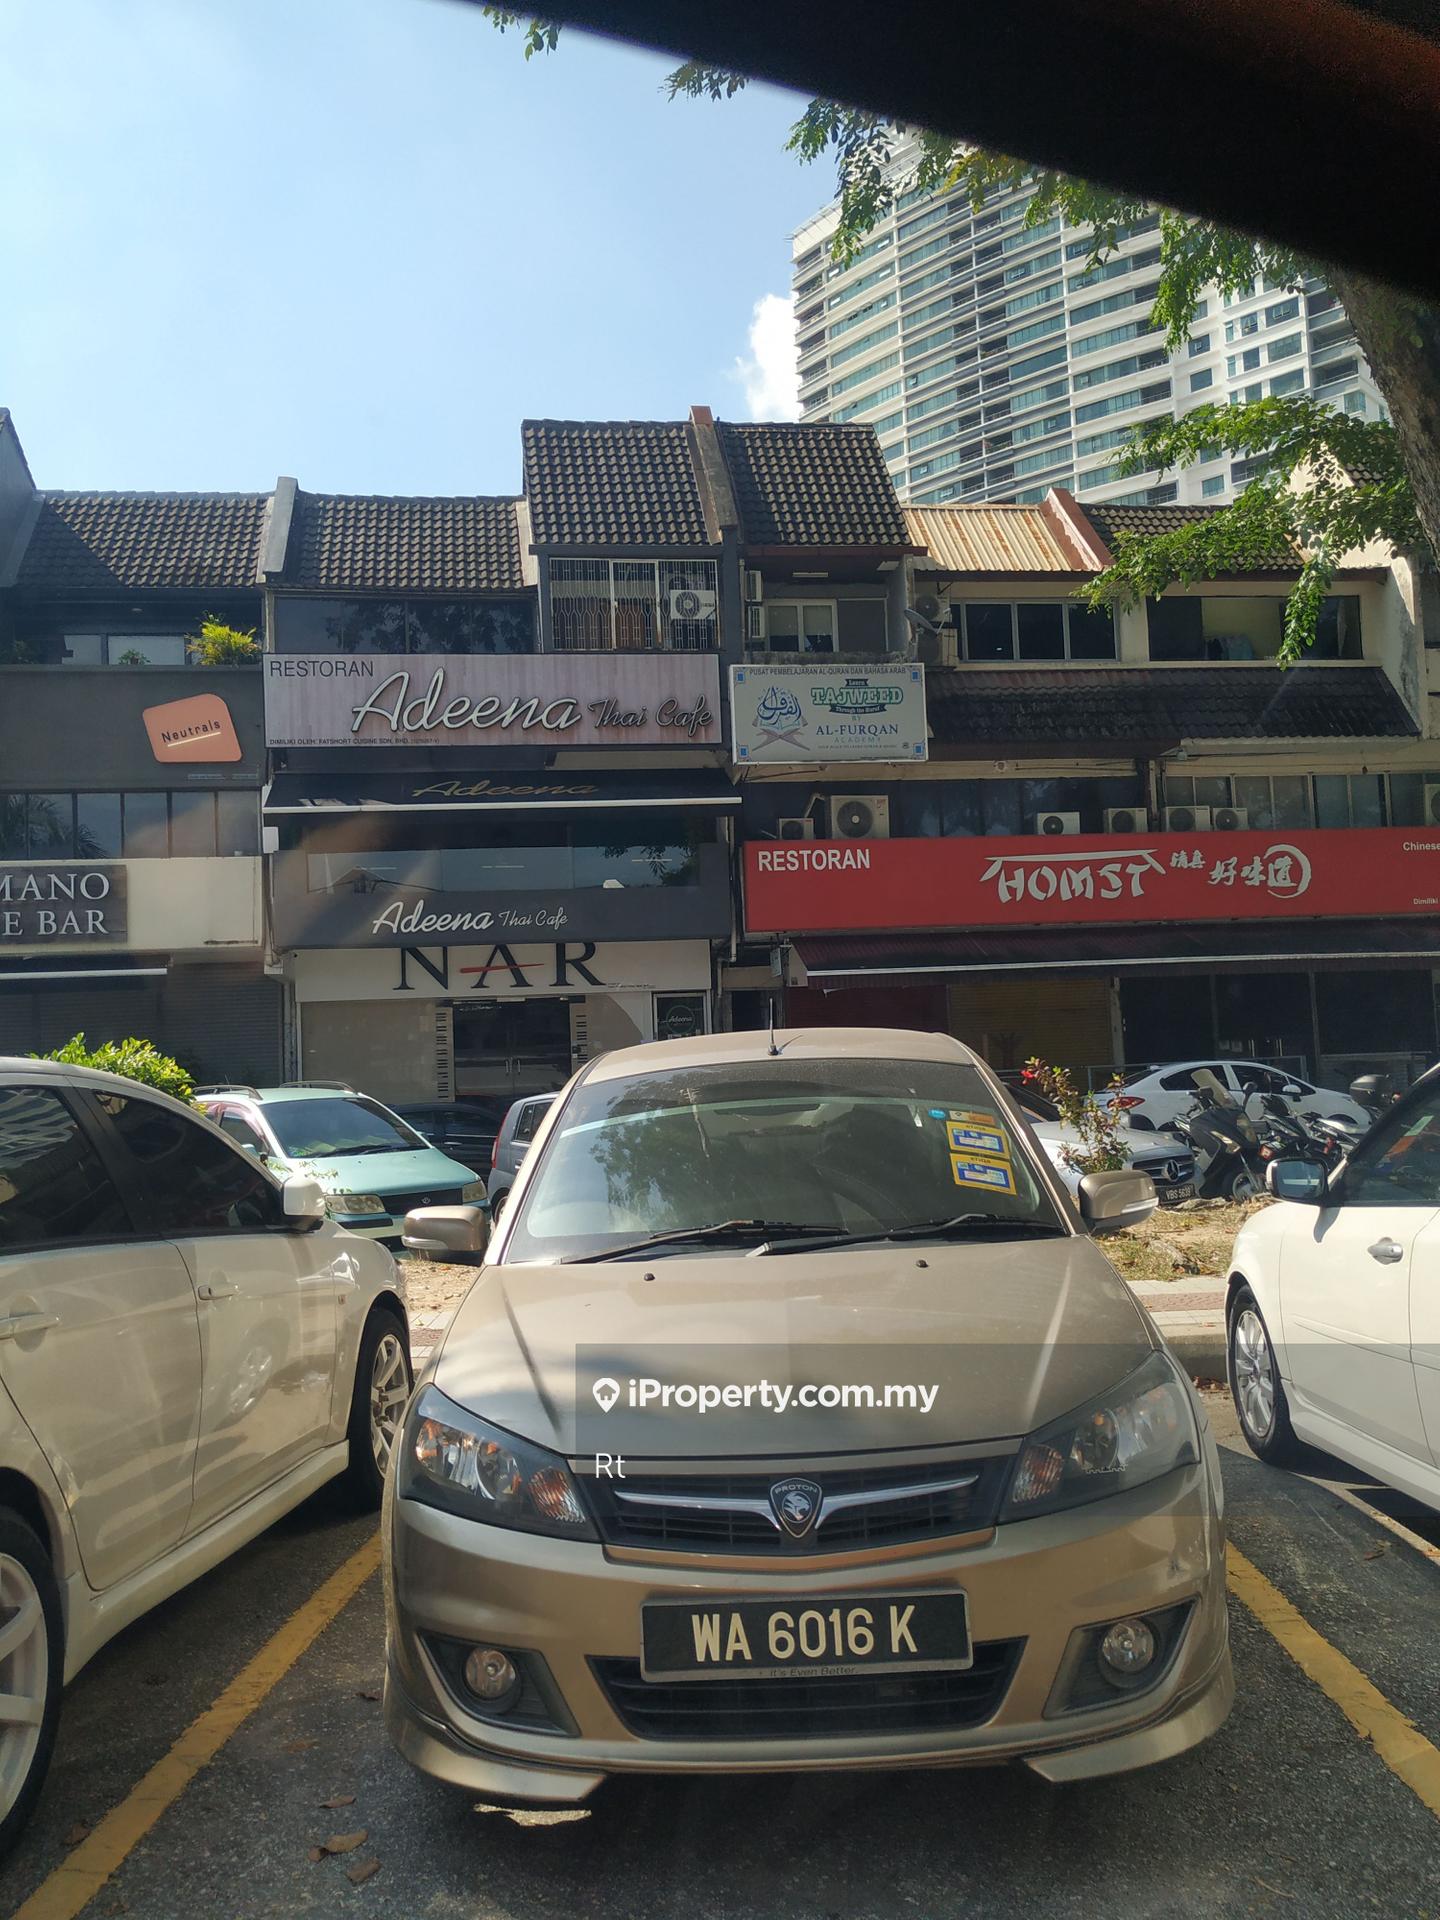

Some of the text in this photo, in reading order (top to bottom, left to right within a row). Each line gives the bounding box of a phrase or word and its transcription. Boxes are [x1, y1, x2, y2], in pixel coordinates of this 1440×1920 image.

[270, 661, 374, 677] RESTORAN
[351, 667, 713, 736] Adeena Thai Cafe
[811, 687, 903, 705] TAJWEED
[161, 719, 221, 743] Neutrals
[816, 724, 898, 736] AL-FURQAN
[411, 779, 600, 797] Adeena
[1402, 841, 1440, 852] Chinese
[758, 848, 871, 871] RESTORAN
[37, 909, 109, 935] BAR
[372, 899, 568, 935] Adeena Thai Cafe
[774, 1484, 818, 1494] PROTON
[692, 1604, 918, 1662] WA 6016 K
